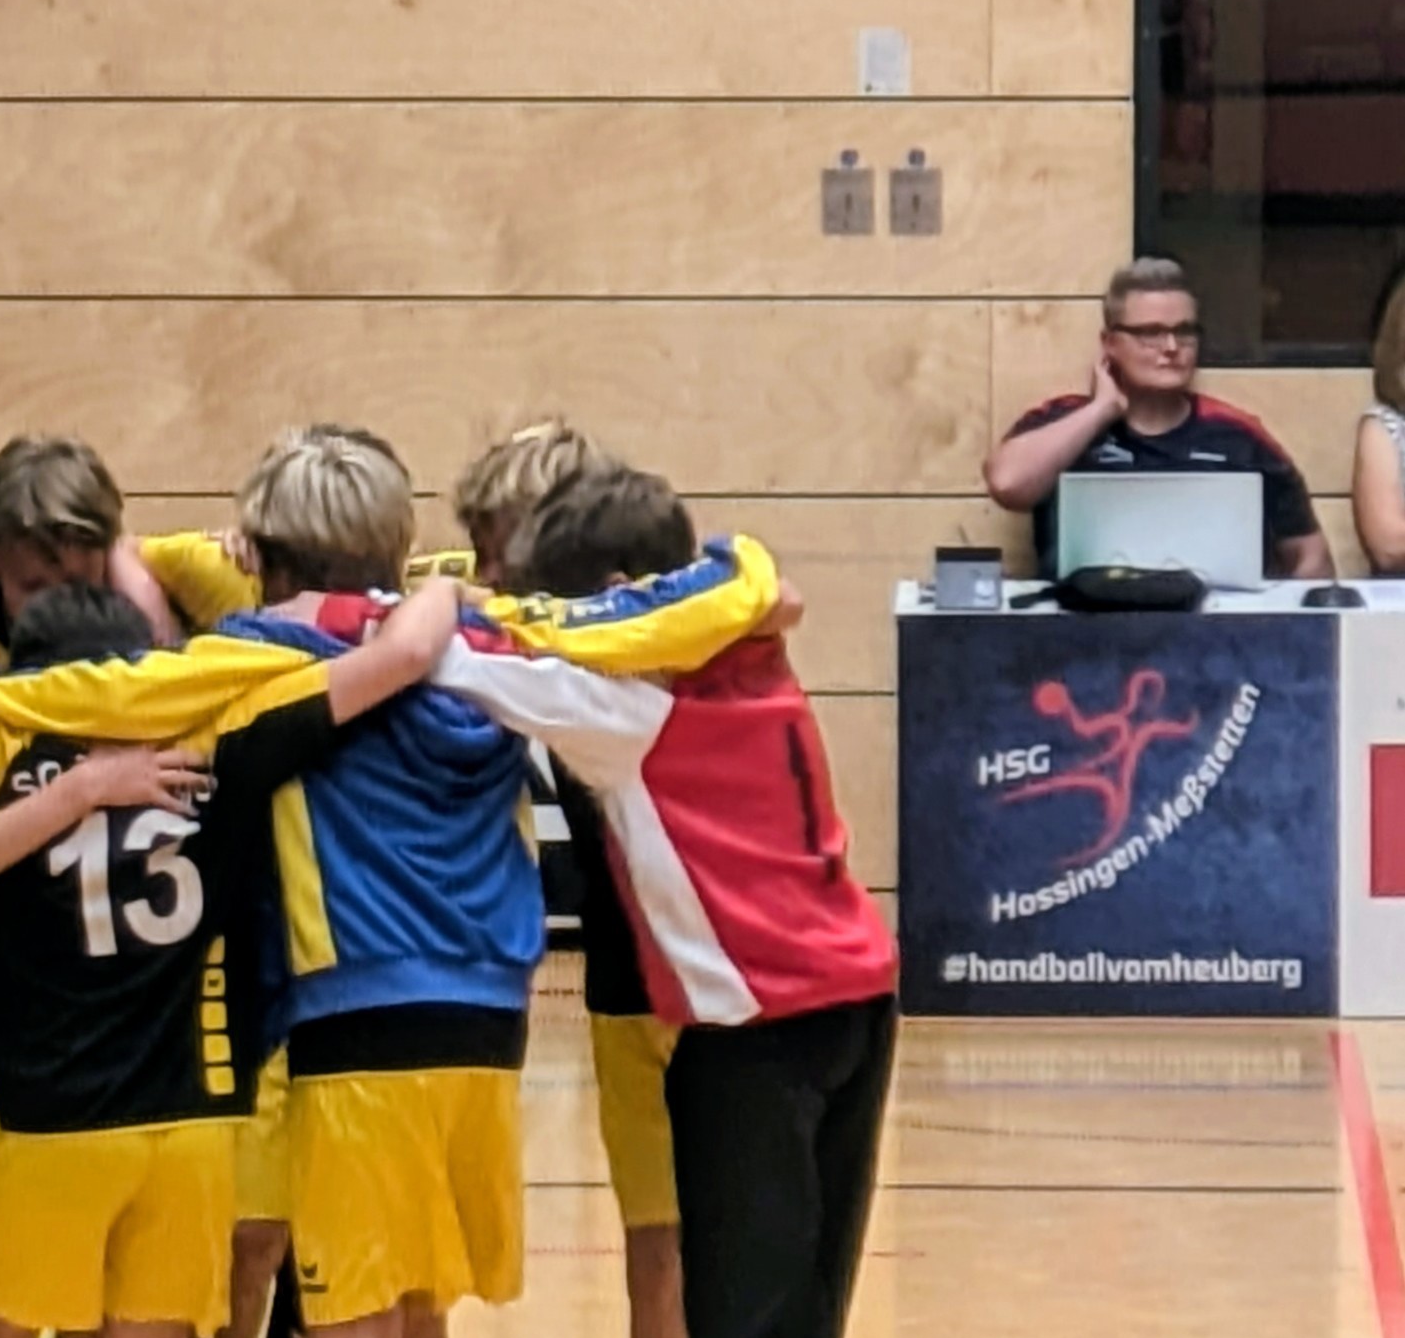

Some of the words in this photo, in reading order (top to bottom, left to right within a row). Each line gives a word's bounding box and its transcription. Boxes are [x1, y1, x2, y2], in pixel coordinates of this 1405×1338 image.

[977, 745, 1052, 786] HSG
[49, 809, 204, 957] 13
[942, 952, 1302, 988] #handballvomheuberg
